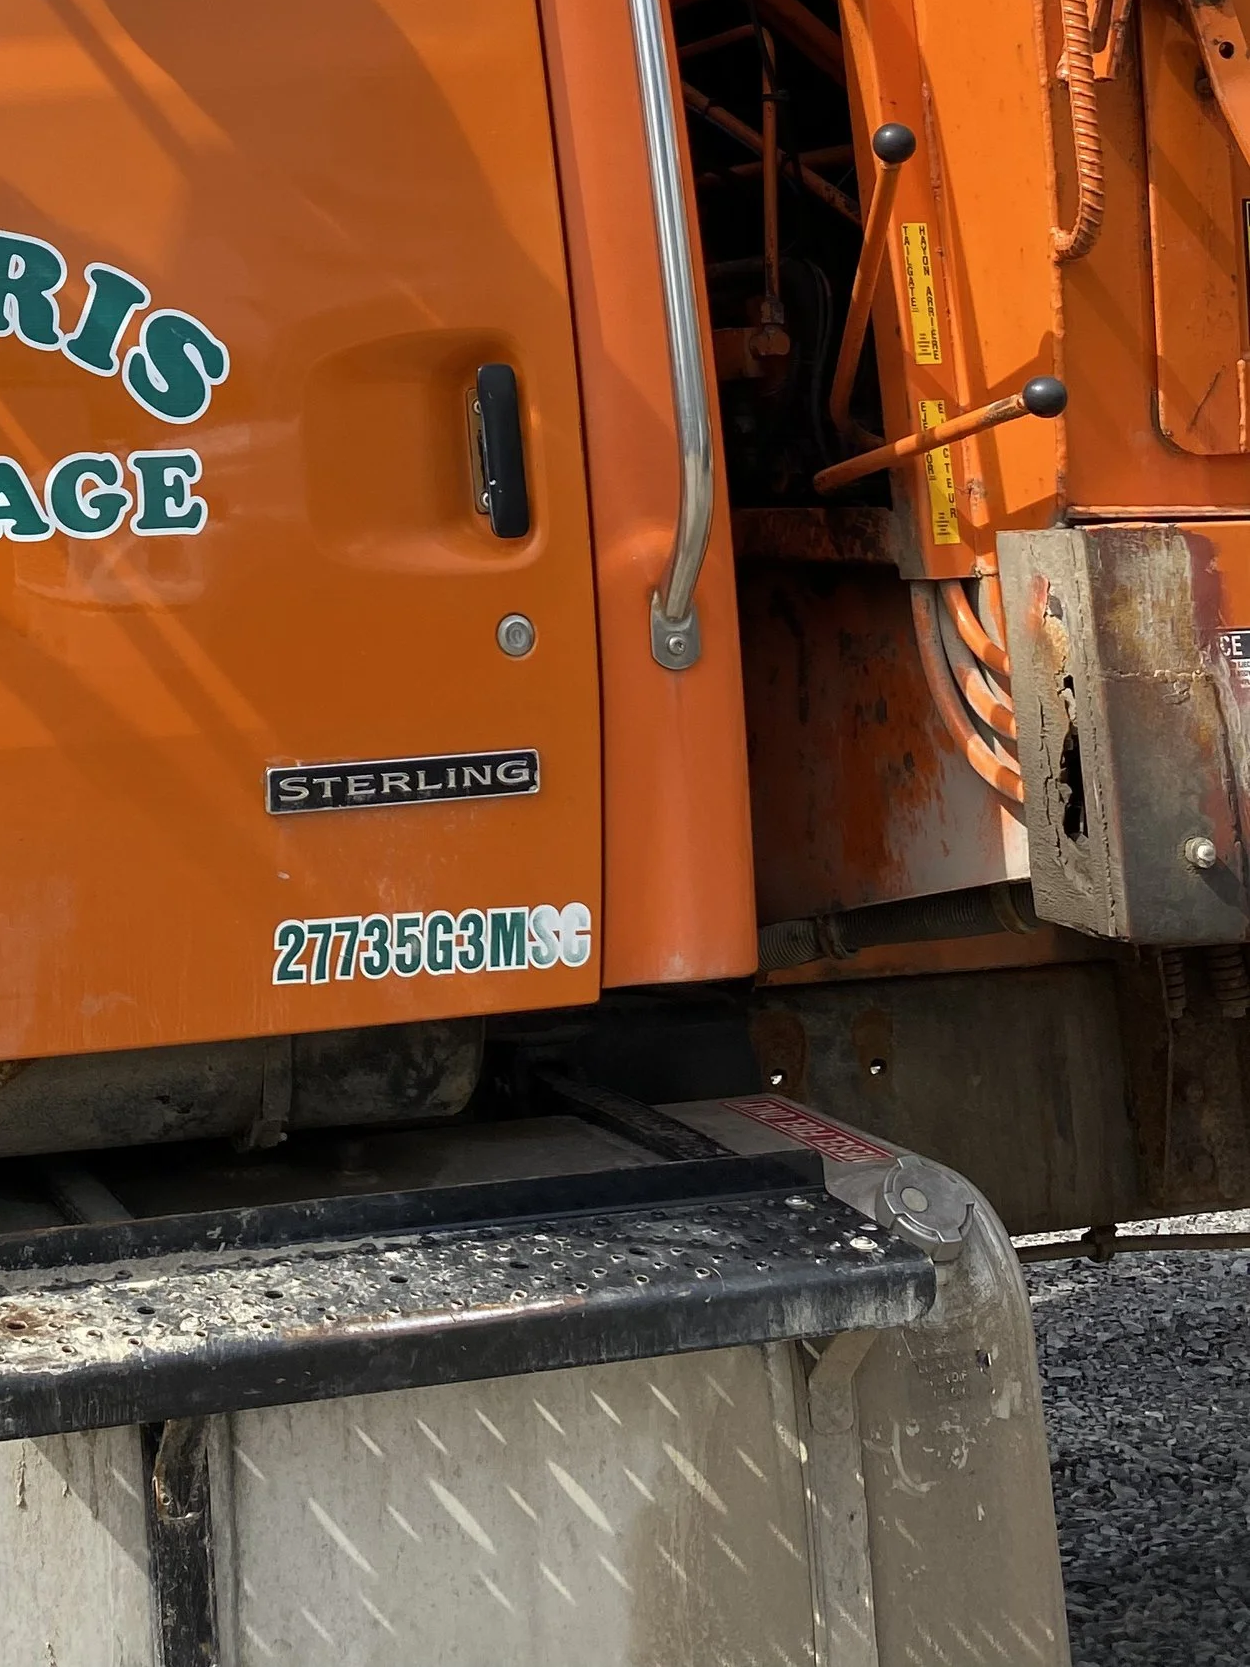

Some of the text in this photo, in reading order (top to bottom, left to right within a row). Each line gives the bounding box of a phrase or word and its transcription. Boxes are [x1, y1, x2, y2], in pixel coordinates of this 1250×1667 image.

[902, 225, 917, 307] TAILGATE
[918, 225, 930, 277] HAYON
[278, 760, 528, 801] STERLING
[734, 1101, 796, 1119] ONLY
[776, 1118, 836, 1137] FUEL
